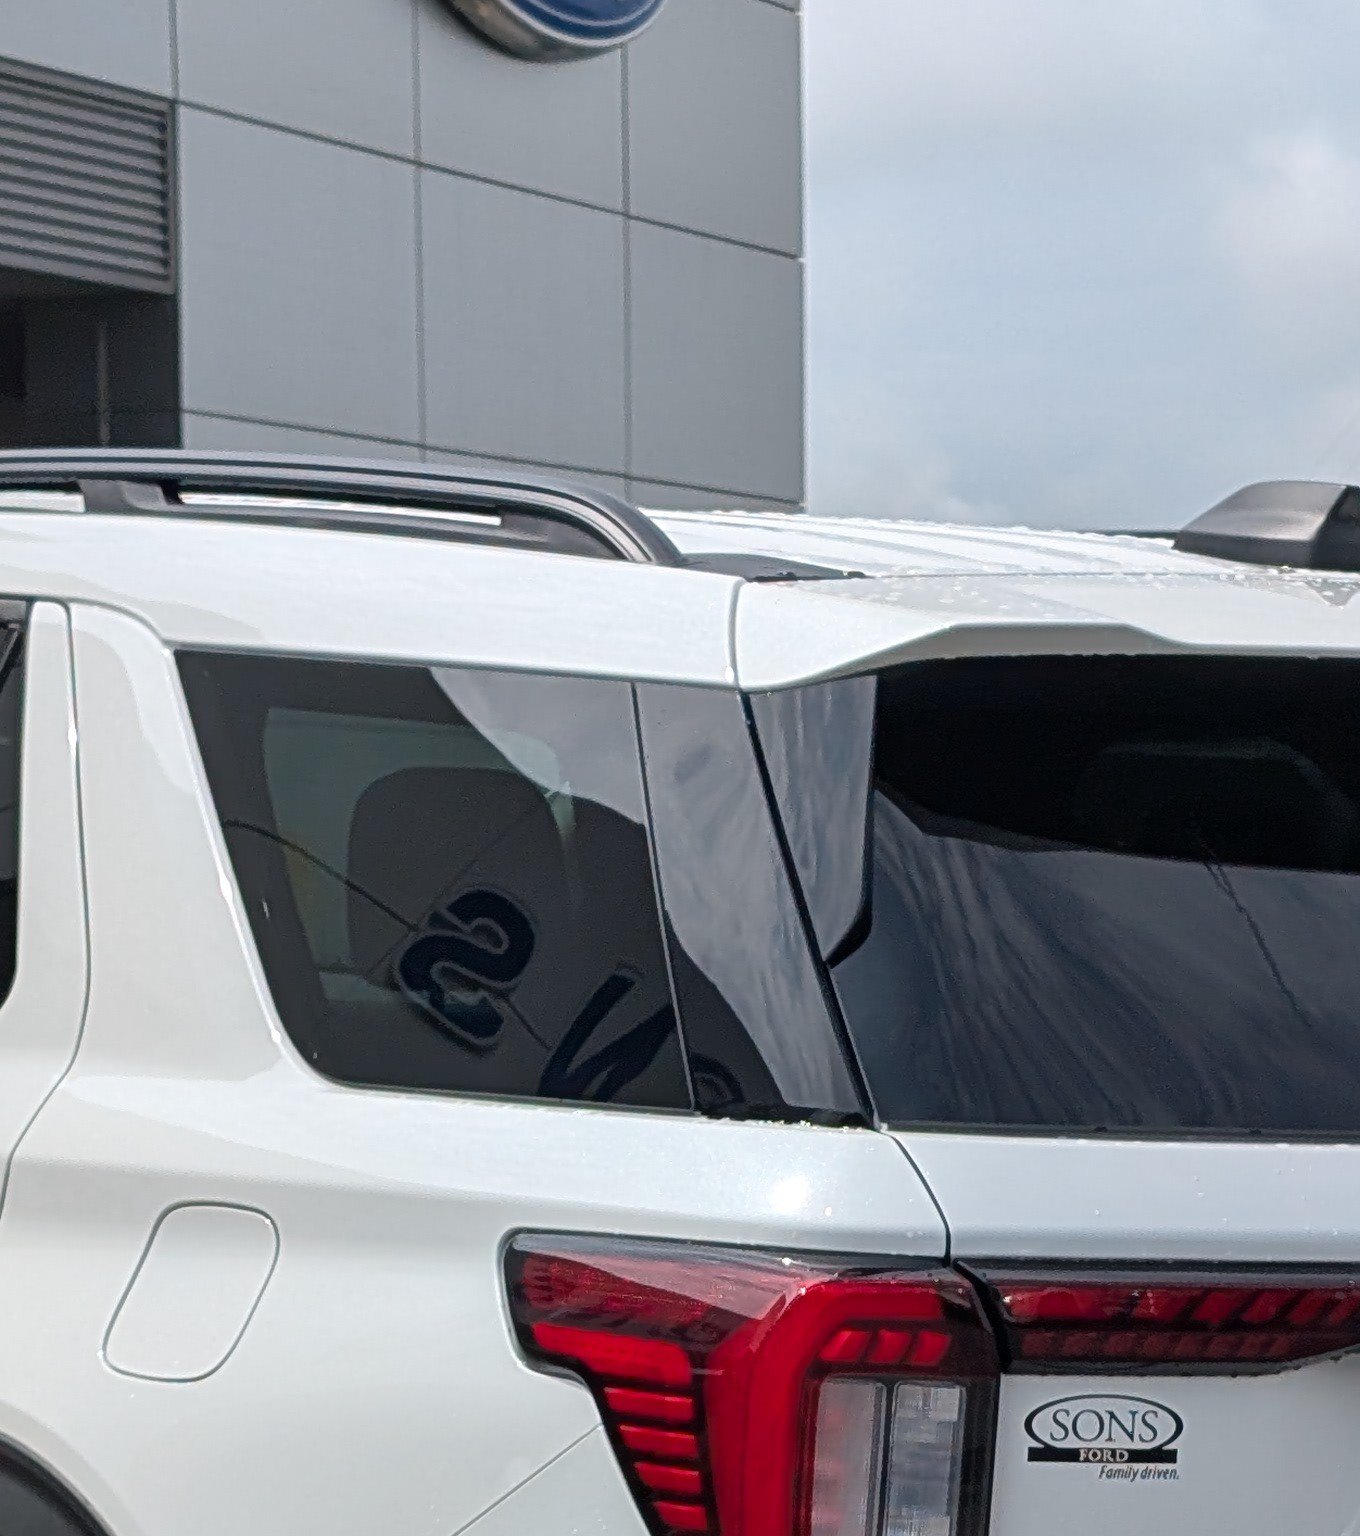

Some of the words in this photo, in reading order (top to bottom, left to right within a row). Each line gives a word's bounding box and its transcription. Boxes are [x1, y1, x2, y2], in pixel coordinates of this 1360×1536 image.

[1049, 1408, 1159, 1444] SONS
[1078, 1448, 1130, 1463] FORD
[1098, 1465, 1139, 1483] Family
[1139, 1465, 1181, 1481] driven.
